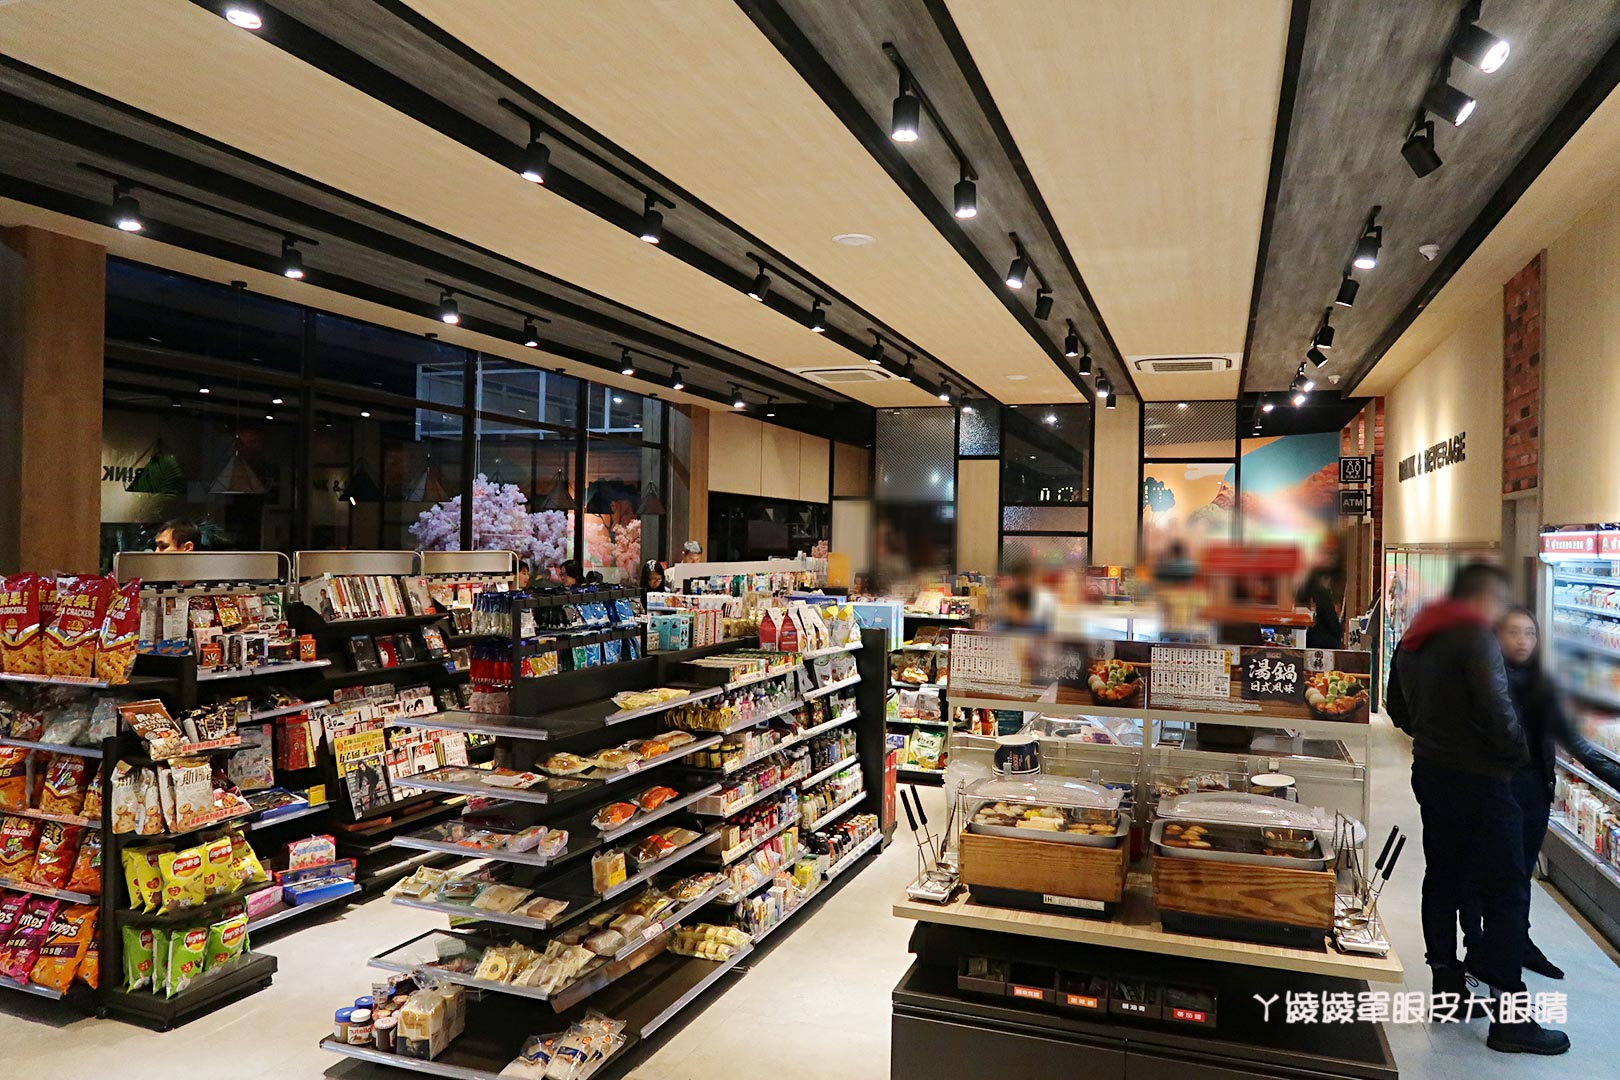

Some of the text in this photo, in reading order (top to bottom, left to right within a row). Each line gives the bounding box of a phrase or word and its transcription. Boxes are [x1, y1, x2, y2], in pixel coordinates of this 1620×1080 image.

[1424, 431, 1466, 473] BEVERAGE
[1343, 498, 1363, 507] ATM
[66, 607, 95, 619] CRACKERS
[1248, 658, 1298, 683] 湯鍋
[1250, 680, 1296, 694] 日式風味
[19, 914, 45, 929] ritos
[49, 921, 79, 937] oritos
